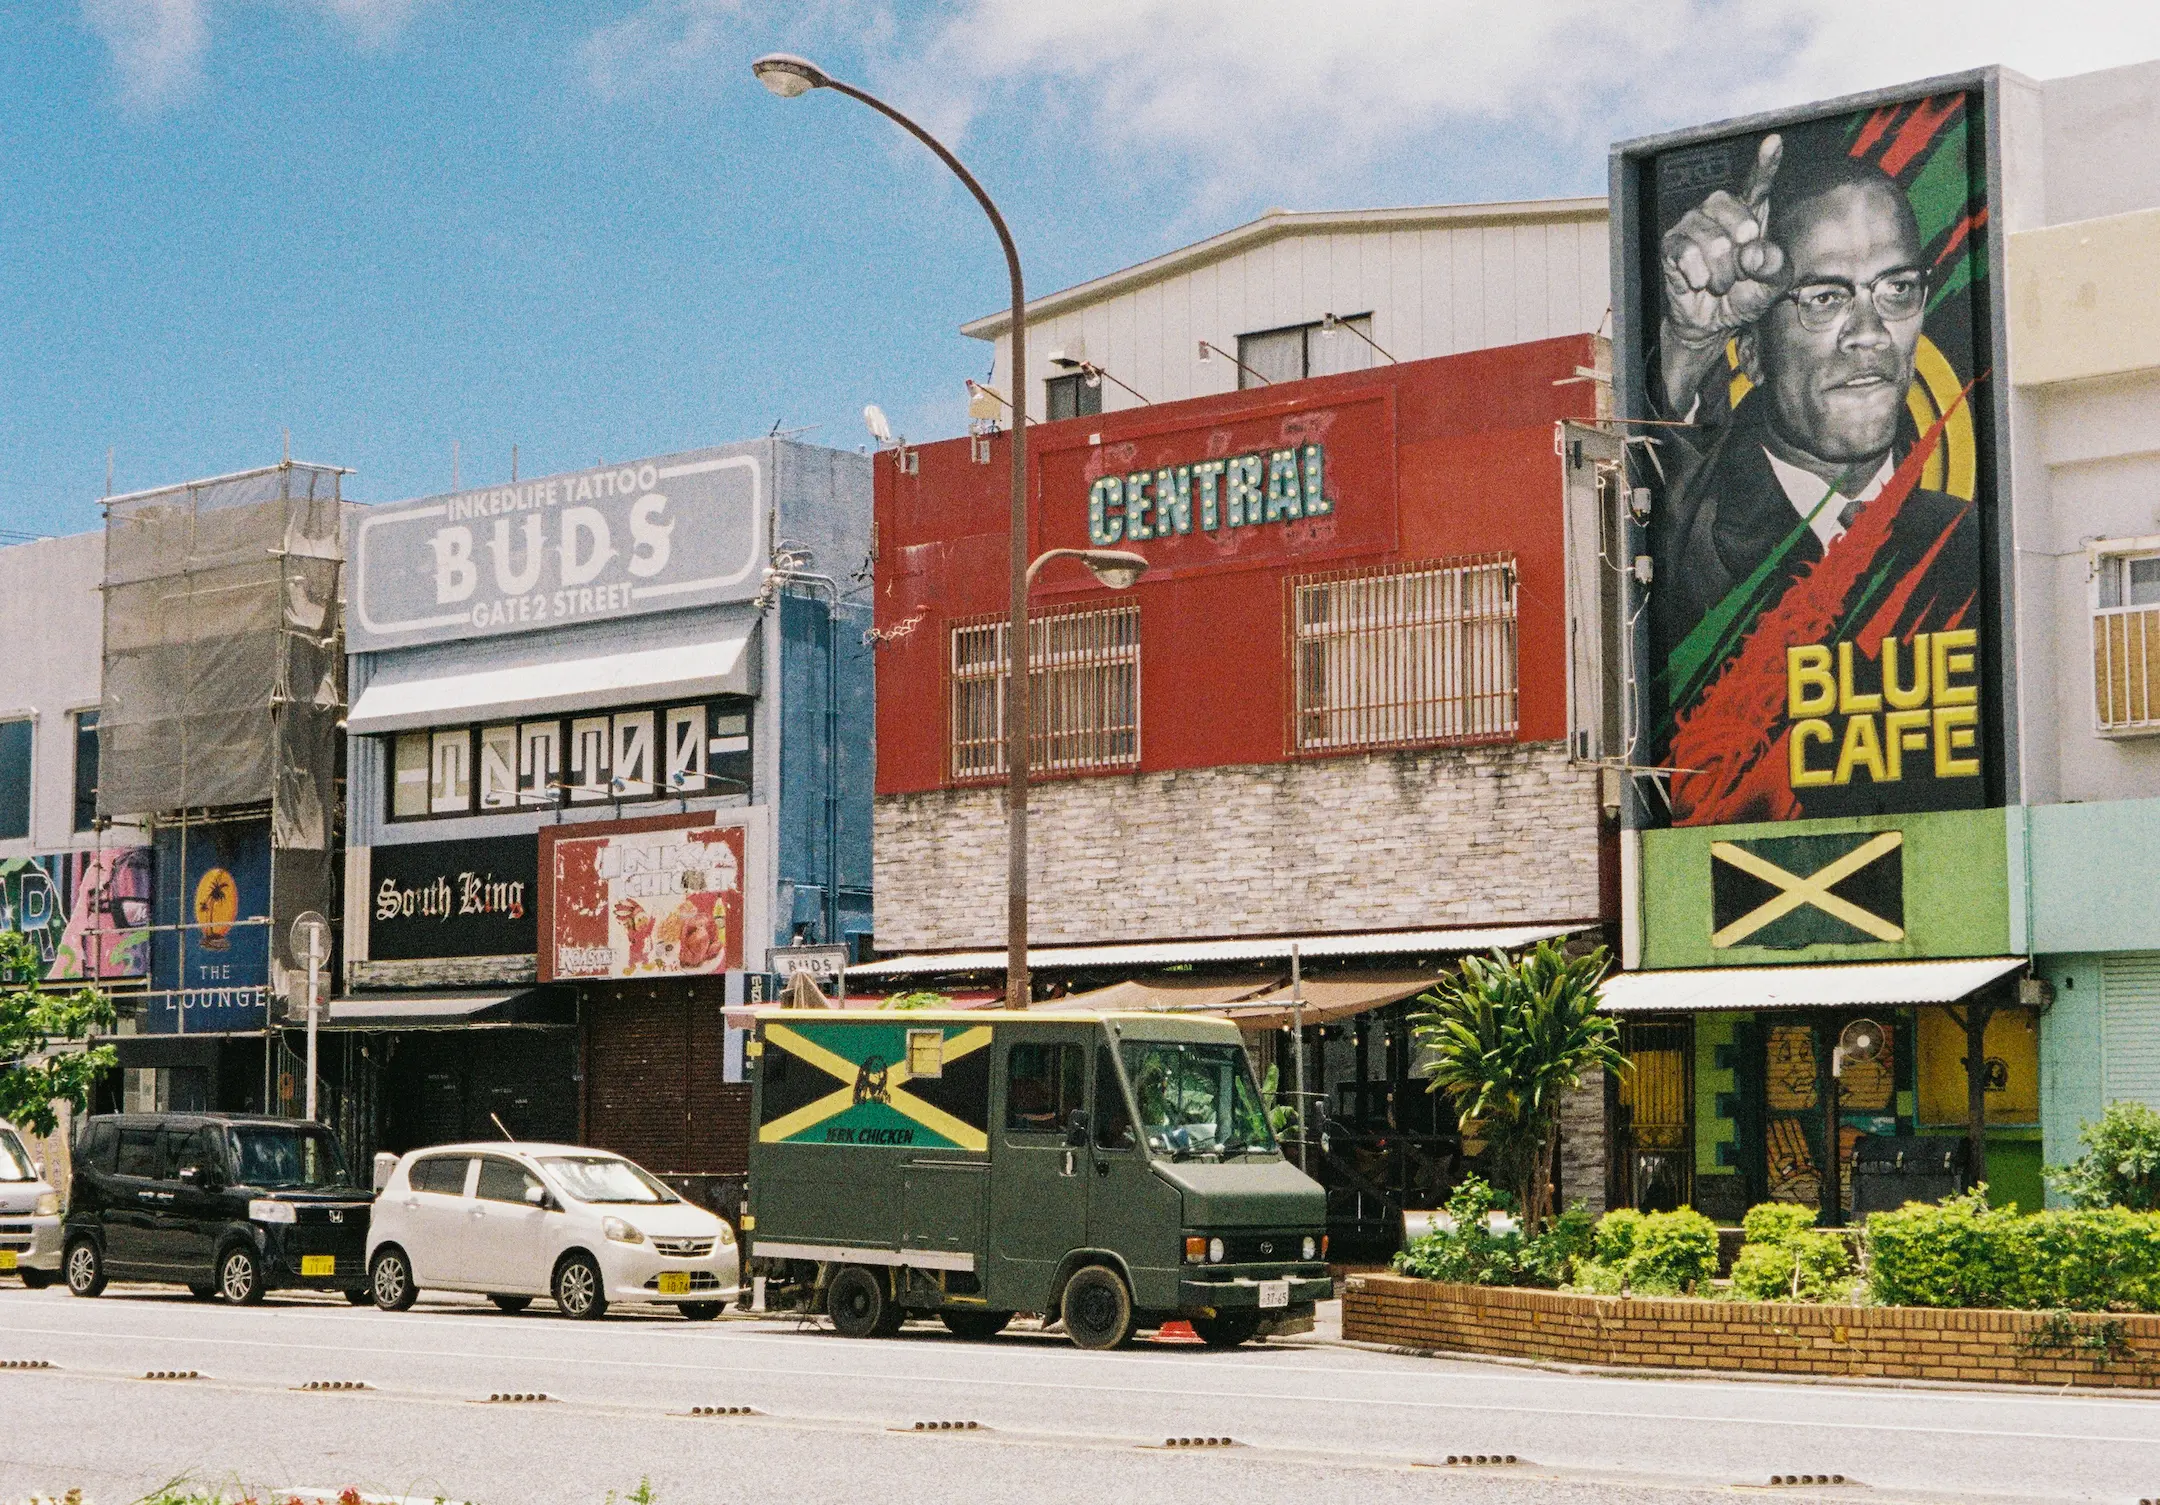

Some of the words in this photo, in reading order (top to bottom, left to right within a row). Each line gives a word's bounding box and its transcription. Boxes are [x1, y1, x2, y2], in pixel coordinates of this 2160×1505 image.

[447, 487, 557, 521] INKEDLIFE
[563, 464, 660, 502] TATTOO
[1088, 443, 1334, 546] CENTRAL
[427, 493, 676, 604] BUDS
[472, 592, 546, 629] GATE2
[554, 582, 635, 618] STREET
[1788, 629, 1978, 719] BLUE
[1790, 705, 1980, 788] CAFE
[376, 875, 451, 923] South
[458, 871, 525, 919] King
[165, 988, 266, 1011] LOUNGE
[200, 965, 230, 980] THE
[825, 1128, 856, 1142] JERK
[858, 1129, 914, 1144] CHICKEN
